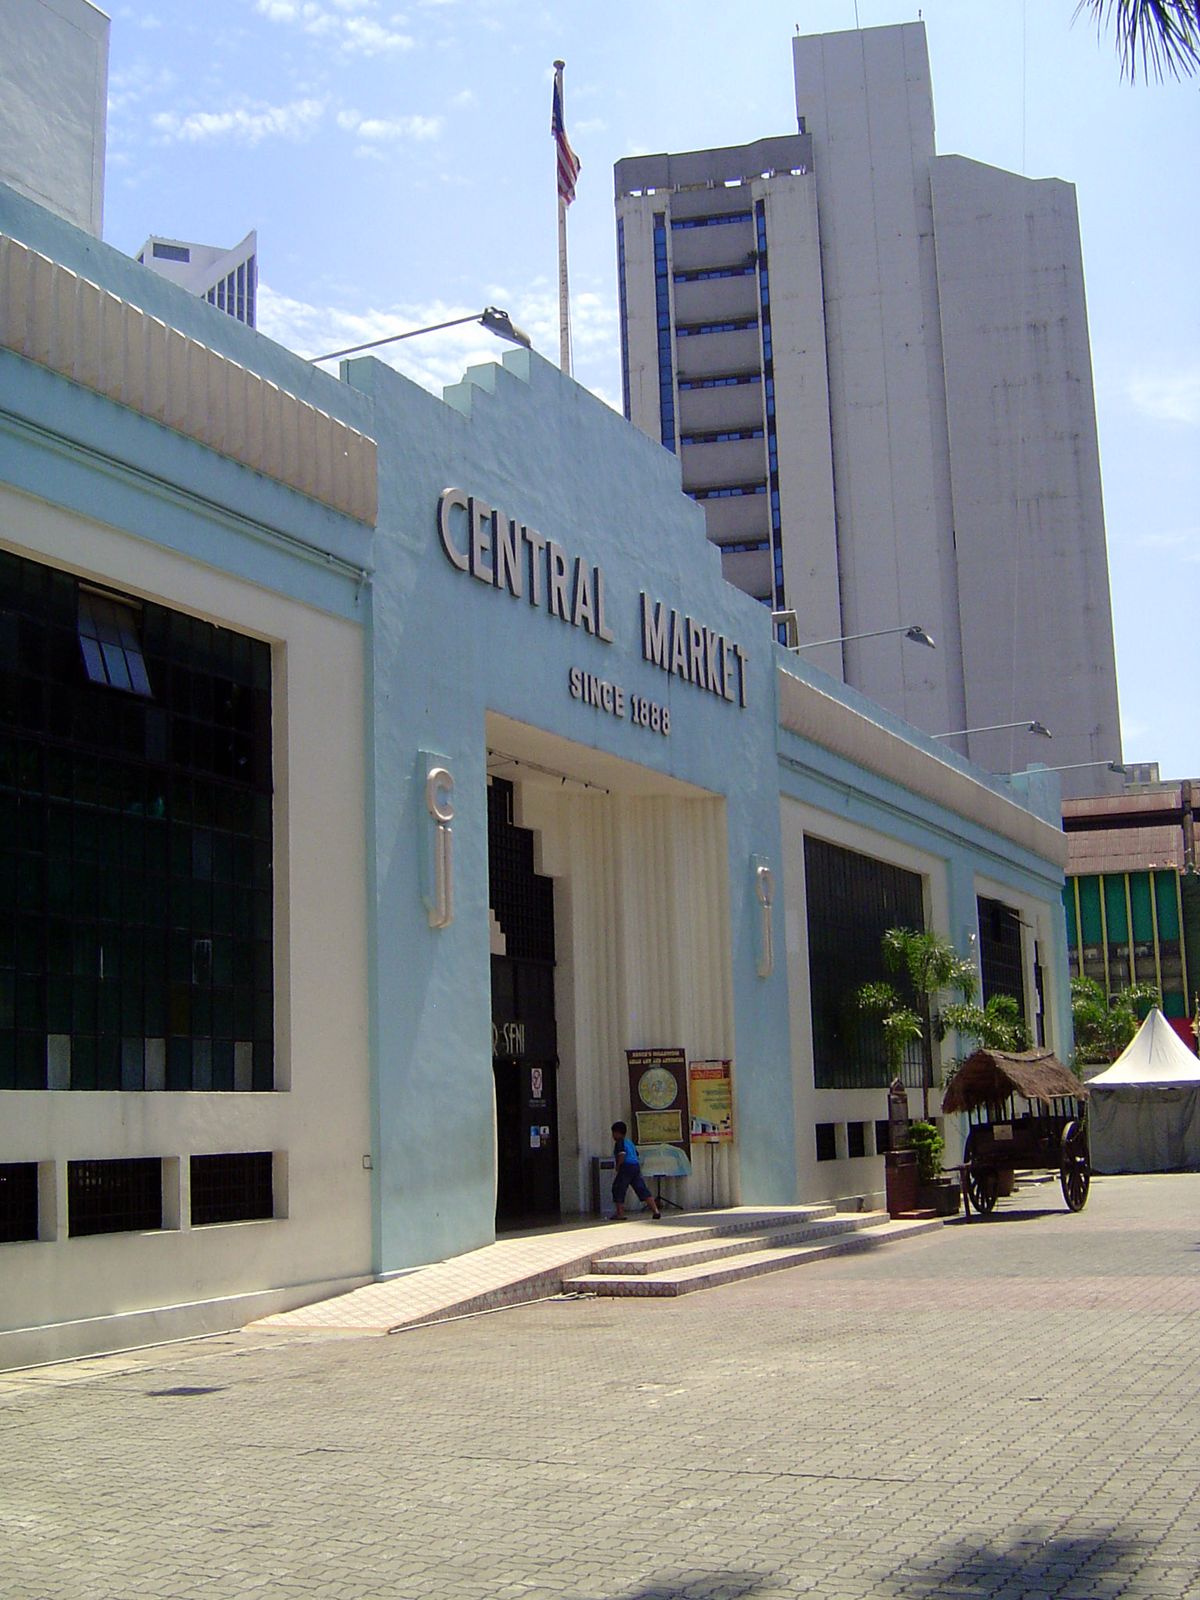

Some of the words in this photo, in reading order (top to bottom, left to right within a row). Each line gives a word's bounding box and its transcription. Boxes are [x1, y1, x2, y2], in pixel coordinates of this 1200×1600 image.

[437, 487, 613, 643] CENTRAL
[639, 590, 748, 708] MARKET
[568, 666, 625, 718] SINCE
[631, 693, 671, 736] 1888
